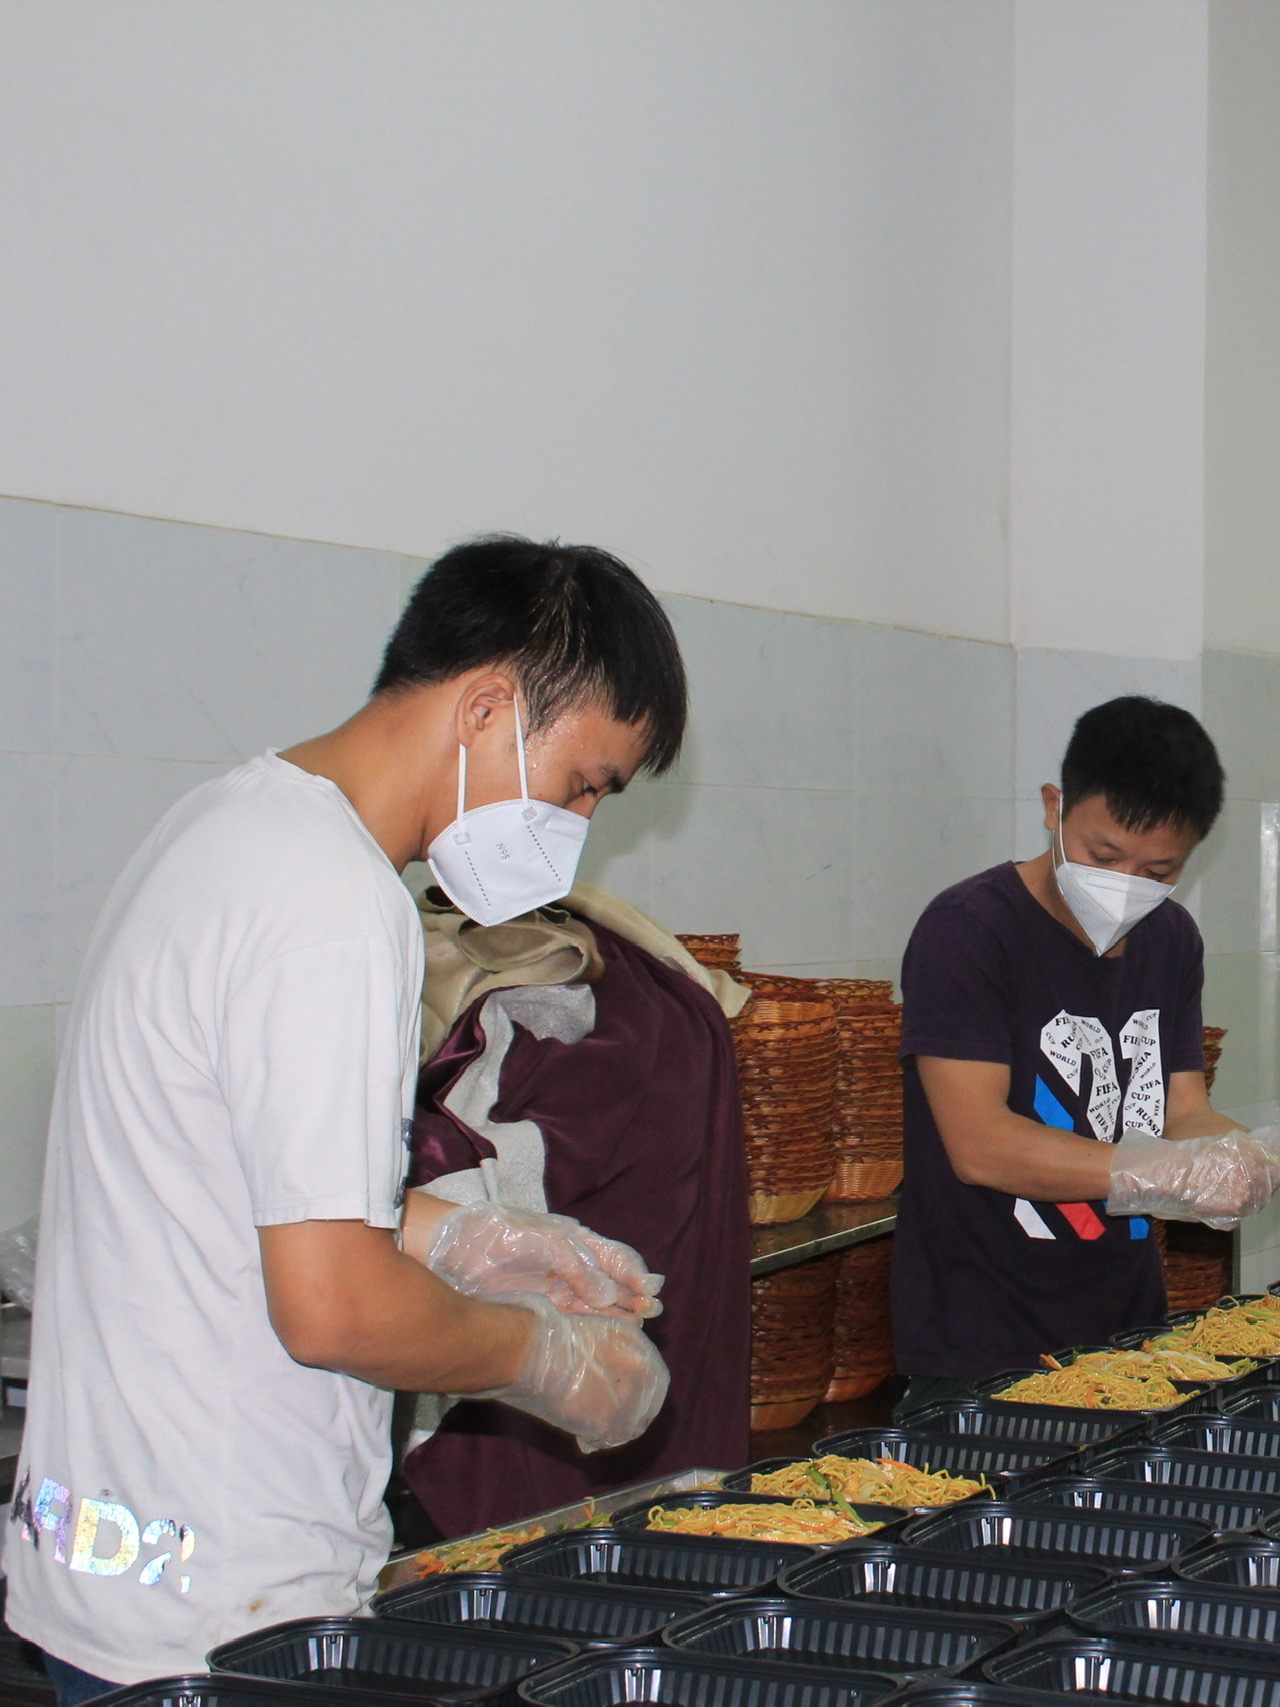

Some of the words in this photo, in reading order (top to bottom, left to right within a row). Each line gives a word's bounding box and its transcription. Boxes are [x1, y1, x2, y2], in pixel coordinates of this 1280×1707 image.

[496, 843, 510, 860] N95
[1081, 1018, 1102, 1034] WORLD
[1049, 1049, 1077, 1067] WORLD
[1096, 1081, 1118, 1097] FIFA
[1139, 1079, 1162, 1091] FIFA
[1131, 1091, 1151, 1101] CUP
[1089, 1097, 1111, 1113] WORLD
[1095, 1113, 1109, 1133] FIFA
[1125, 1120, 1144, 1129] CUP
[1136, 1107, 1161, 1136] RUSSI
